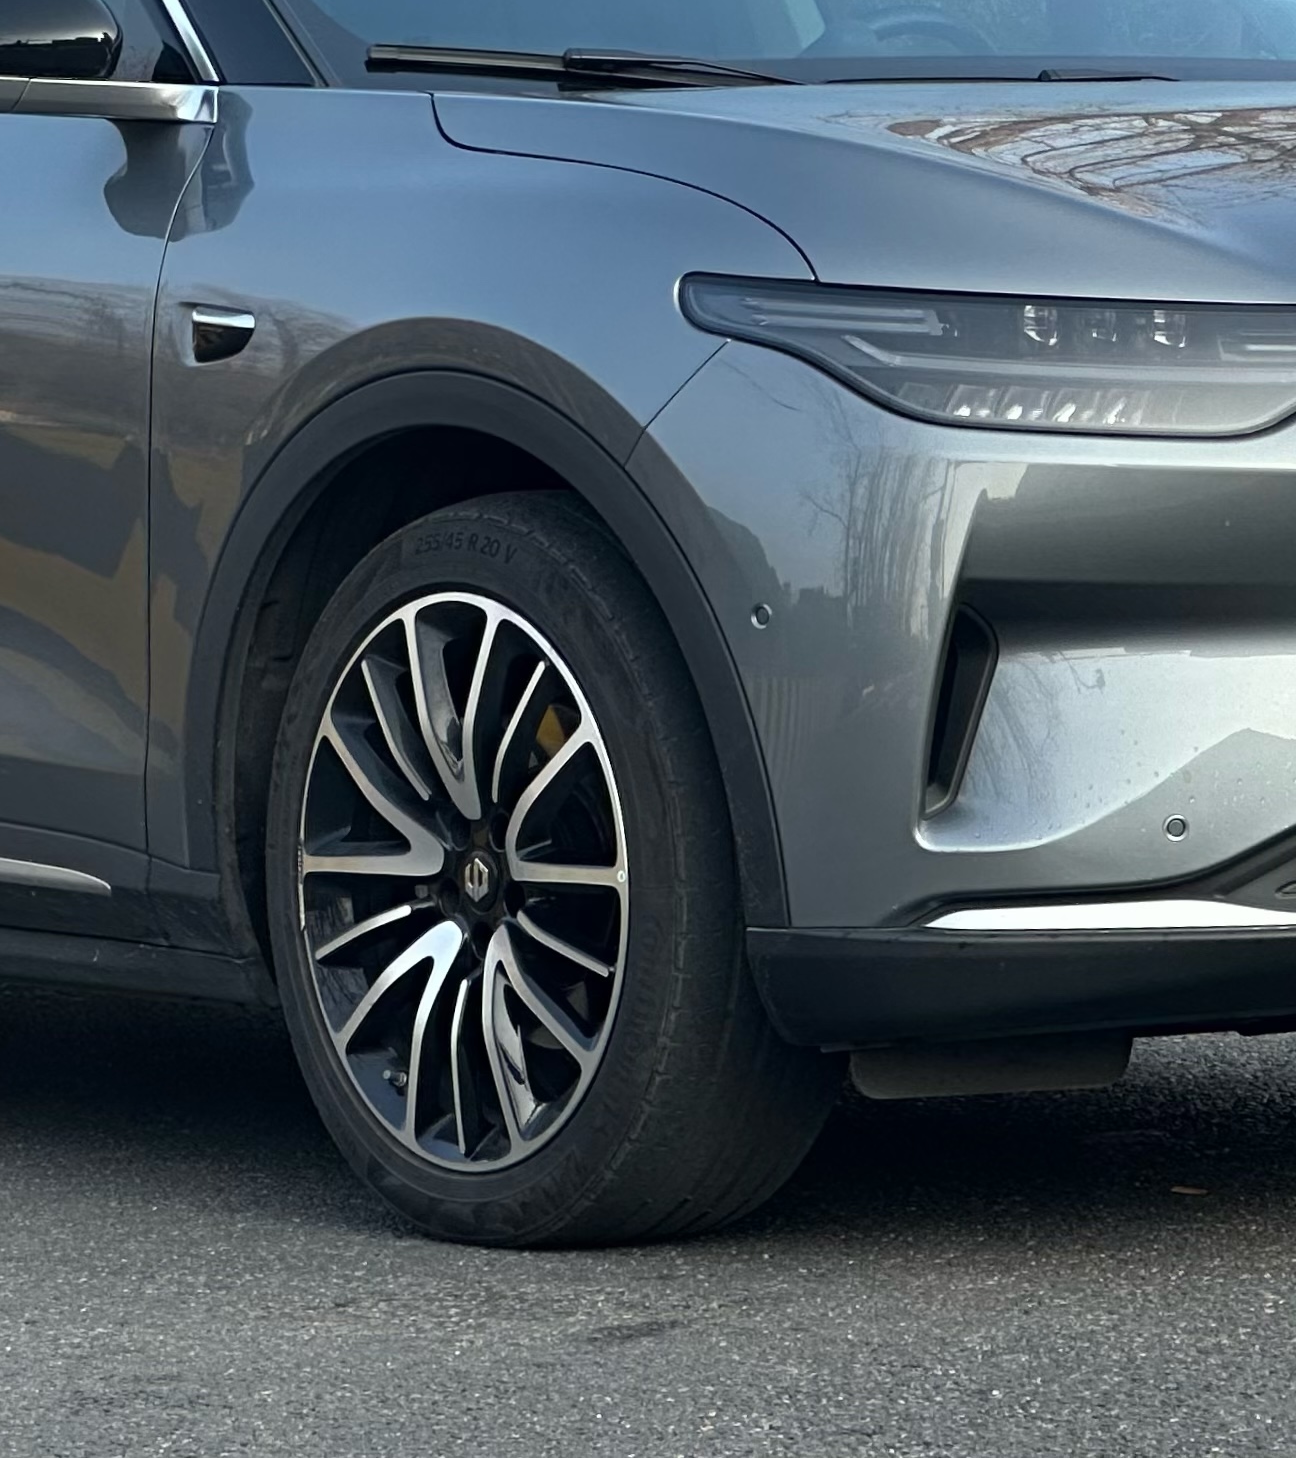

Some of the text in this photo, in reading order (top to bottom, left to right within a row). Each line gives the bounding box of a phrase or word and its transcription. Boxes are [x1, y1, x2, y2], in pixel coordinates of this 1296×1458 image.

[415, 531, 518, 565] 255/45 R 20 V
